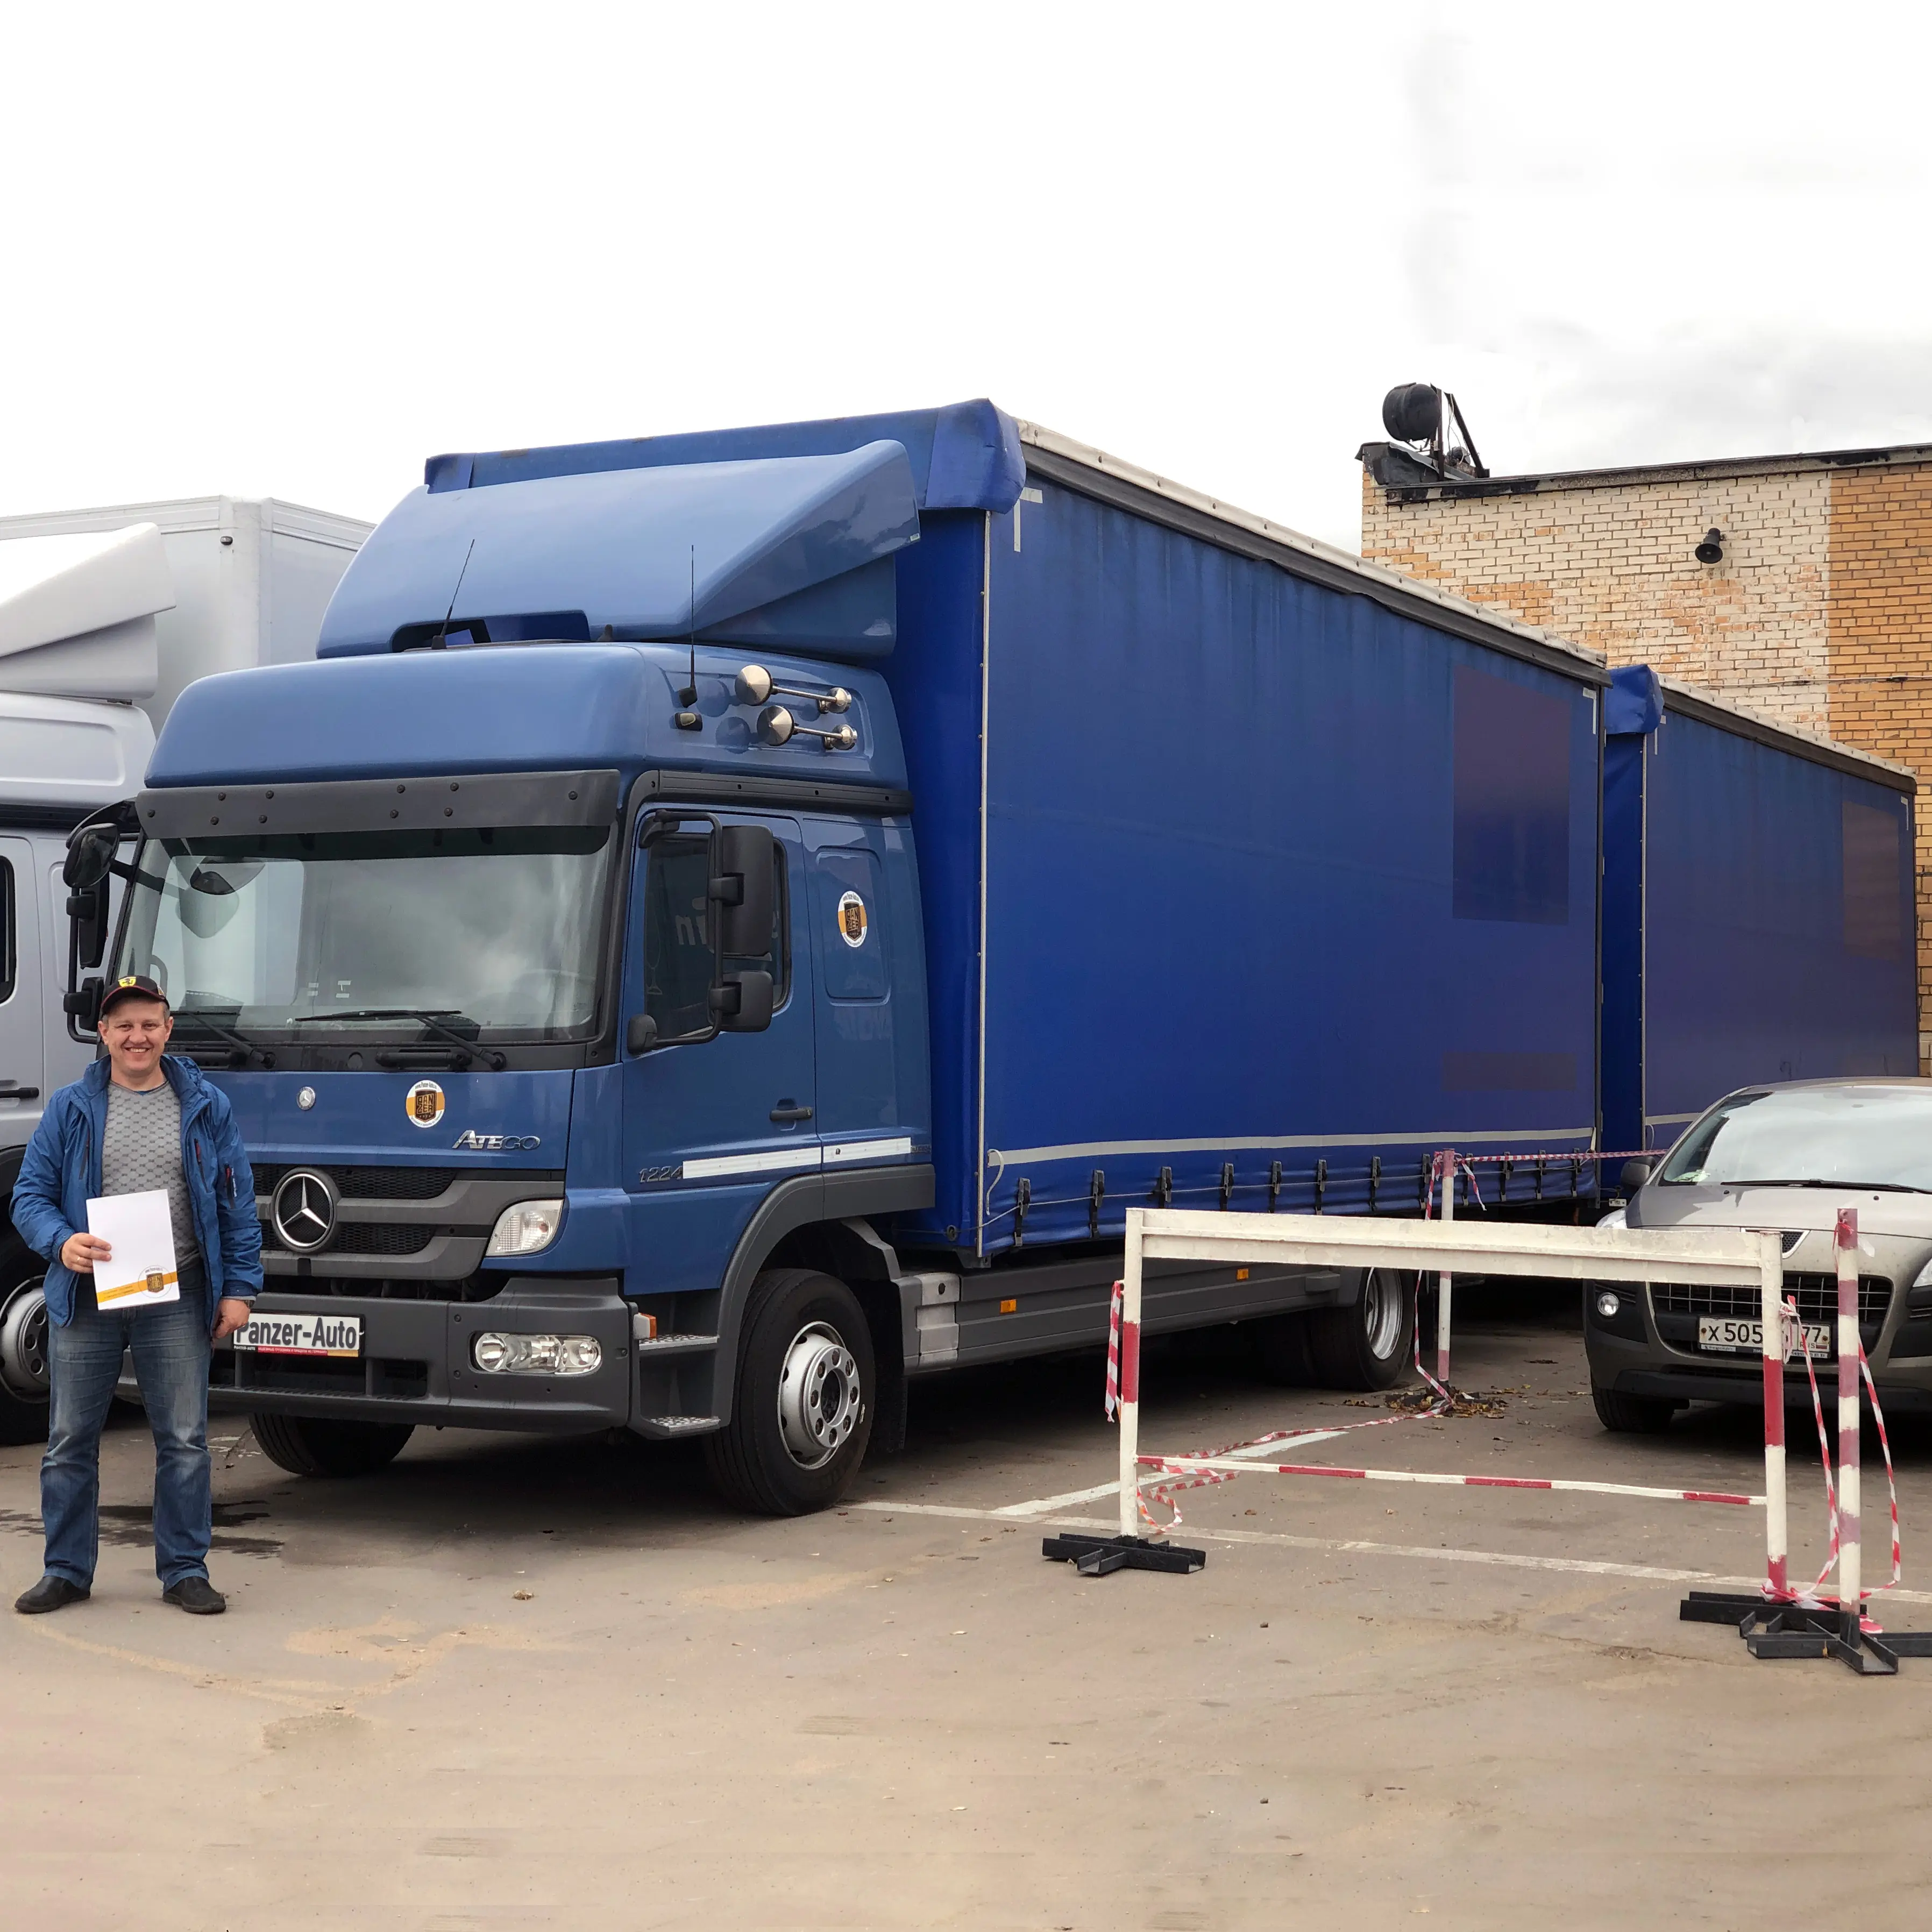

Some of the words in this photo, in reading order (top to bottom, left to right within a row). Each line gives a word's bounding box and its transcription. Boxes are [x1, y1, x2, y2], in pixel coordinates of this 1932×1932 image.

[417, 1094, 433, 1105] PAN
[417, 1104, 434, 1114] ZER
[638, 1165, 683, 1183] 1224
[236, 1317, 357, 1348] Panzer-Auto
[1708, 1322, 1763, 1344] X505
[1802, 1326, 1822, 1343] 77
